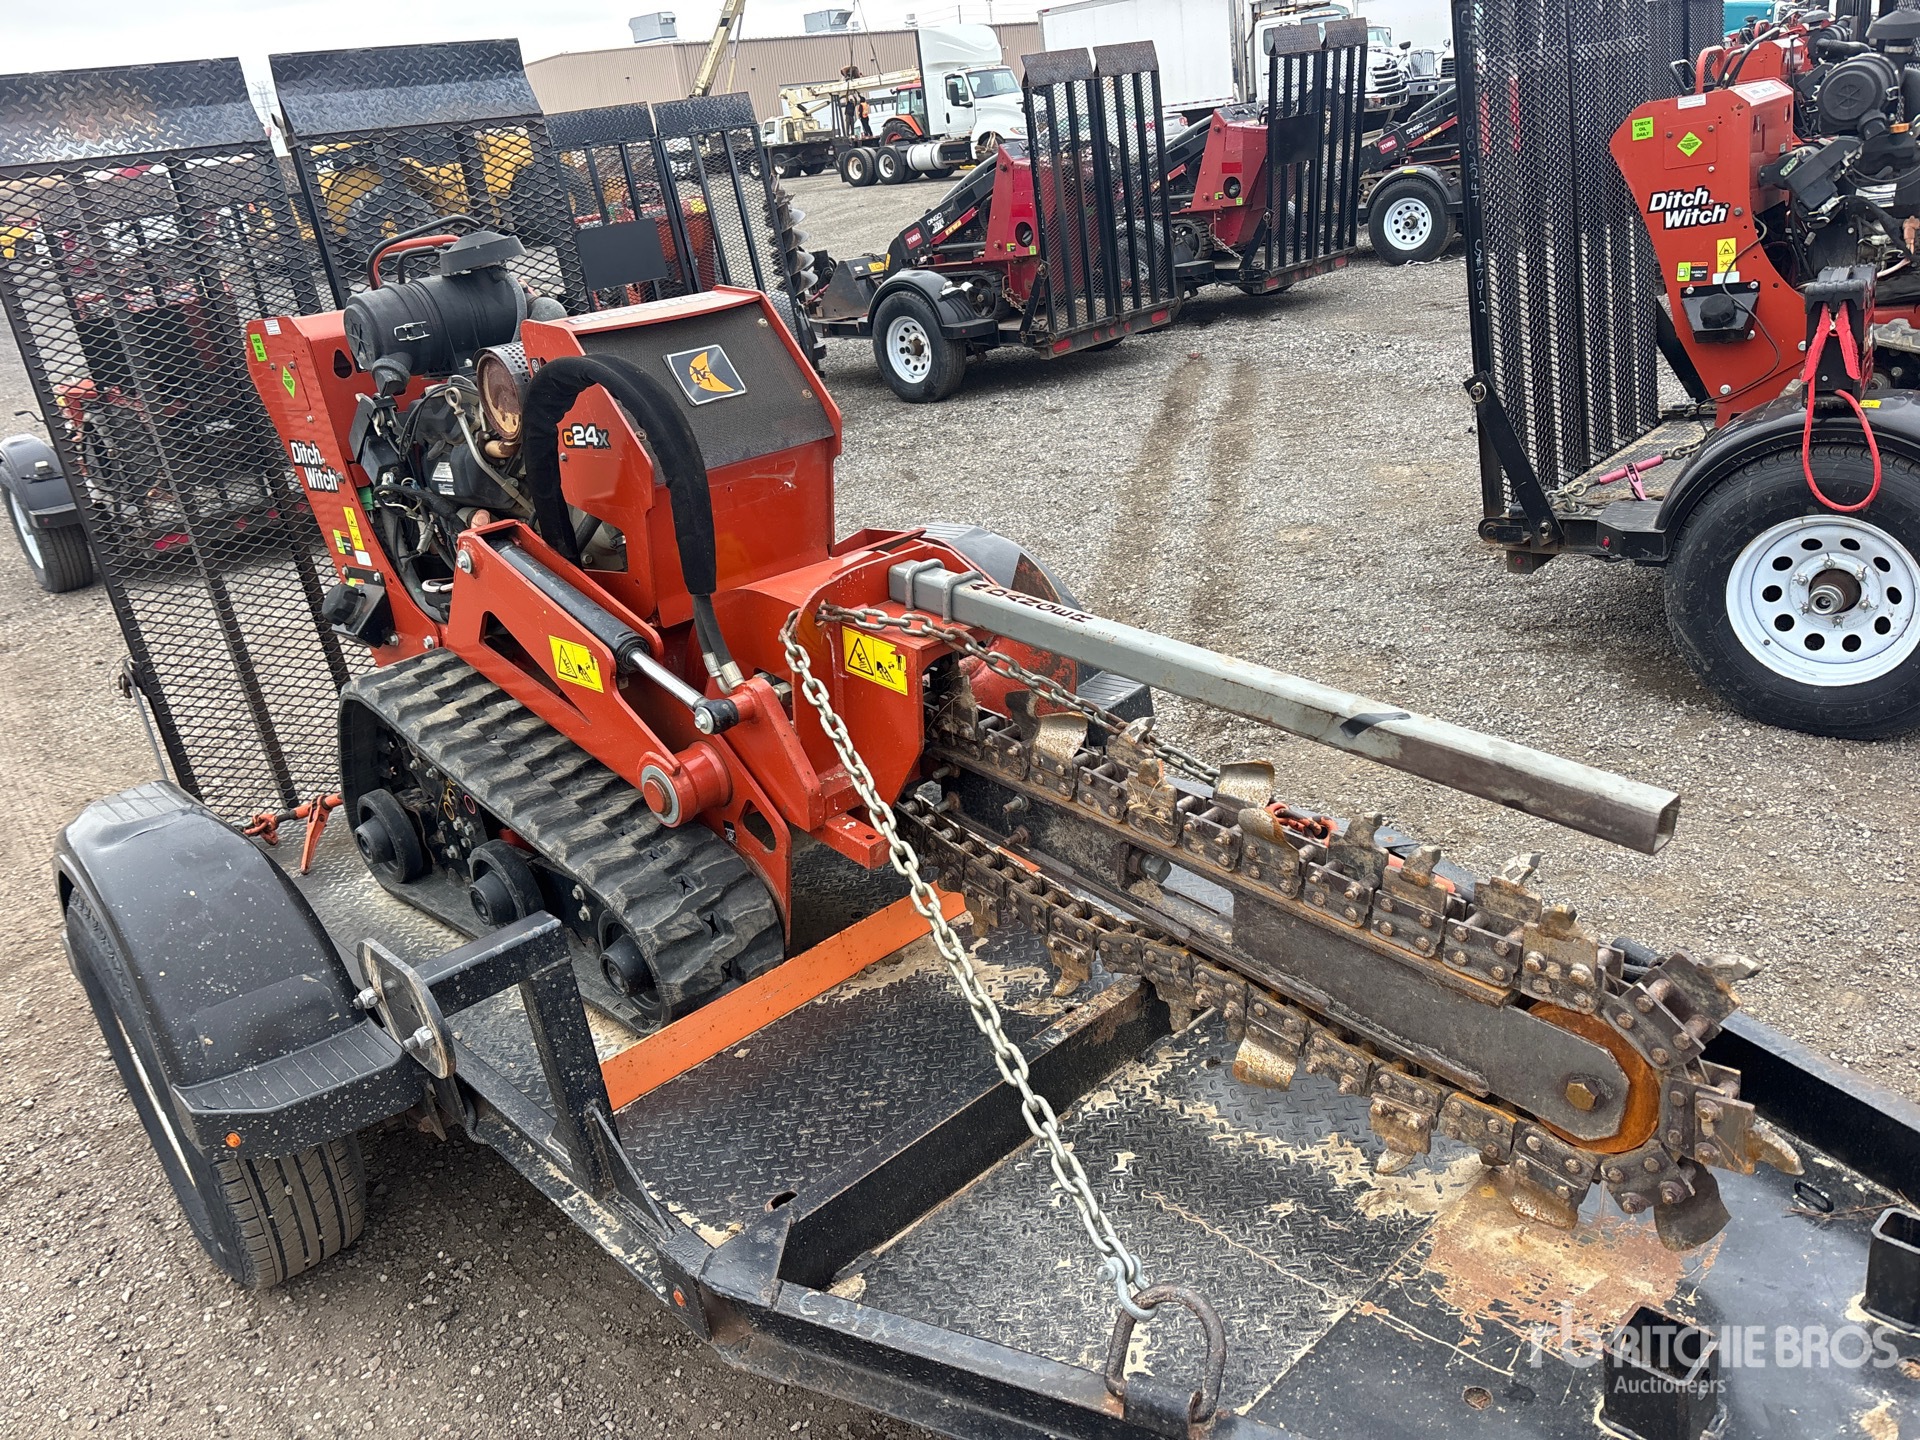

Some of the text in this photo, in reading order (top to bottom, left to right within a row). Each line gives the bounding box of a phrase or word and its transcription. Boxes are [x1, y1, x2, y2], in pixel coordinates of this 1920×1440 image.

[1648, 186, 1710, 212] Ditch
[926, 212, 943, 226] DINGO
[1664, 203, 1728, 229] Witch
[290, 441, 322, 465] Ditch
[304, 466, 339, 491] Witch
[986, 588, 1094, 623] DANGER
